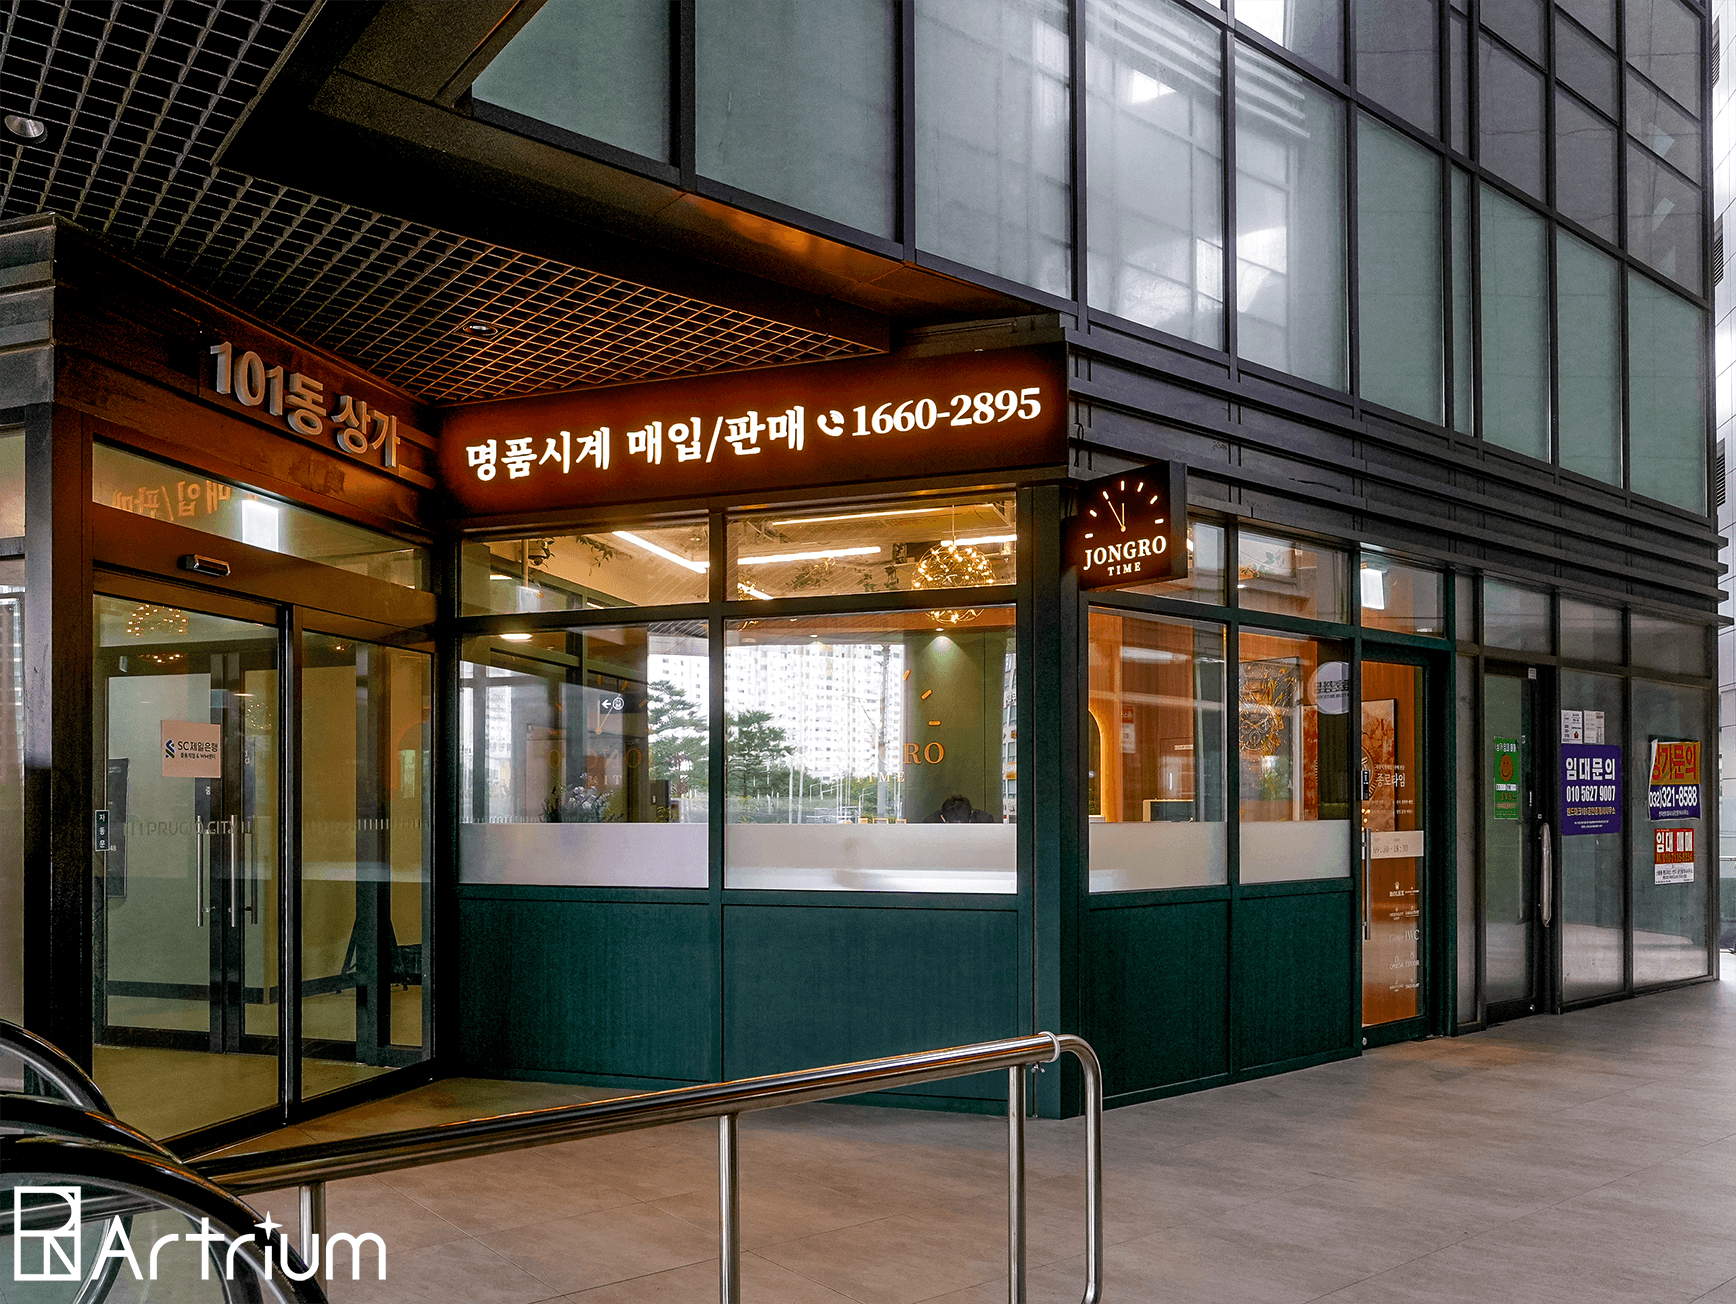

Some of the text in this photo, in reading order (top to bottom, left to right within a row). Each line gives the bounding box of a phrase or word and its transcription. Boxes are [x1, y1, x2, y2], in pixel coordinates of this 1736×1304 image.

[210, 341, 401, 468] 101동 상가
[466, 387, 1041, 481] 명품시계 매입/판매 1660-2895
[1083, 535, 1167, 570] JONGRO
[1107, 562, 1142, 576] TIME
[177, 741, 218, 752] SC제일은행
[1376, 772, 1406, 788] 종로타임
[1565, 758, 1616, 781] 임대문의
[1566, 786, 1616, 802] 010 5627 9007
[1656, 832, 1673, 853] 임대
